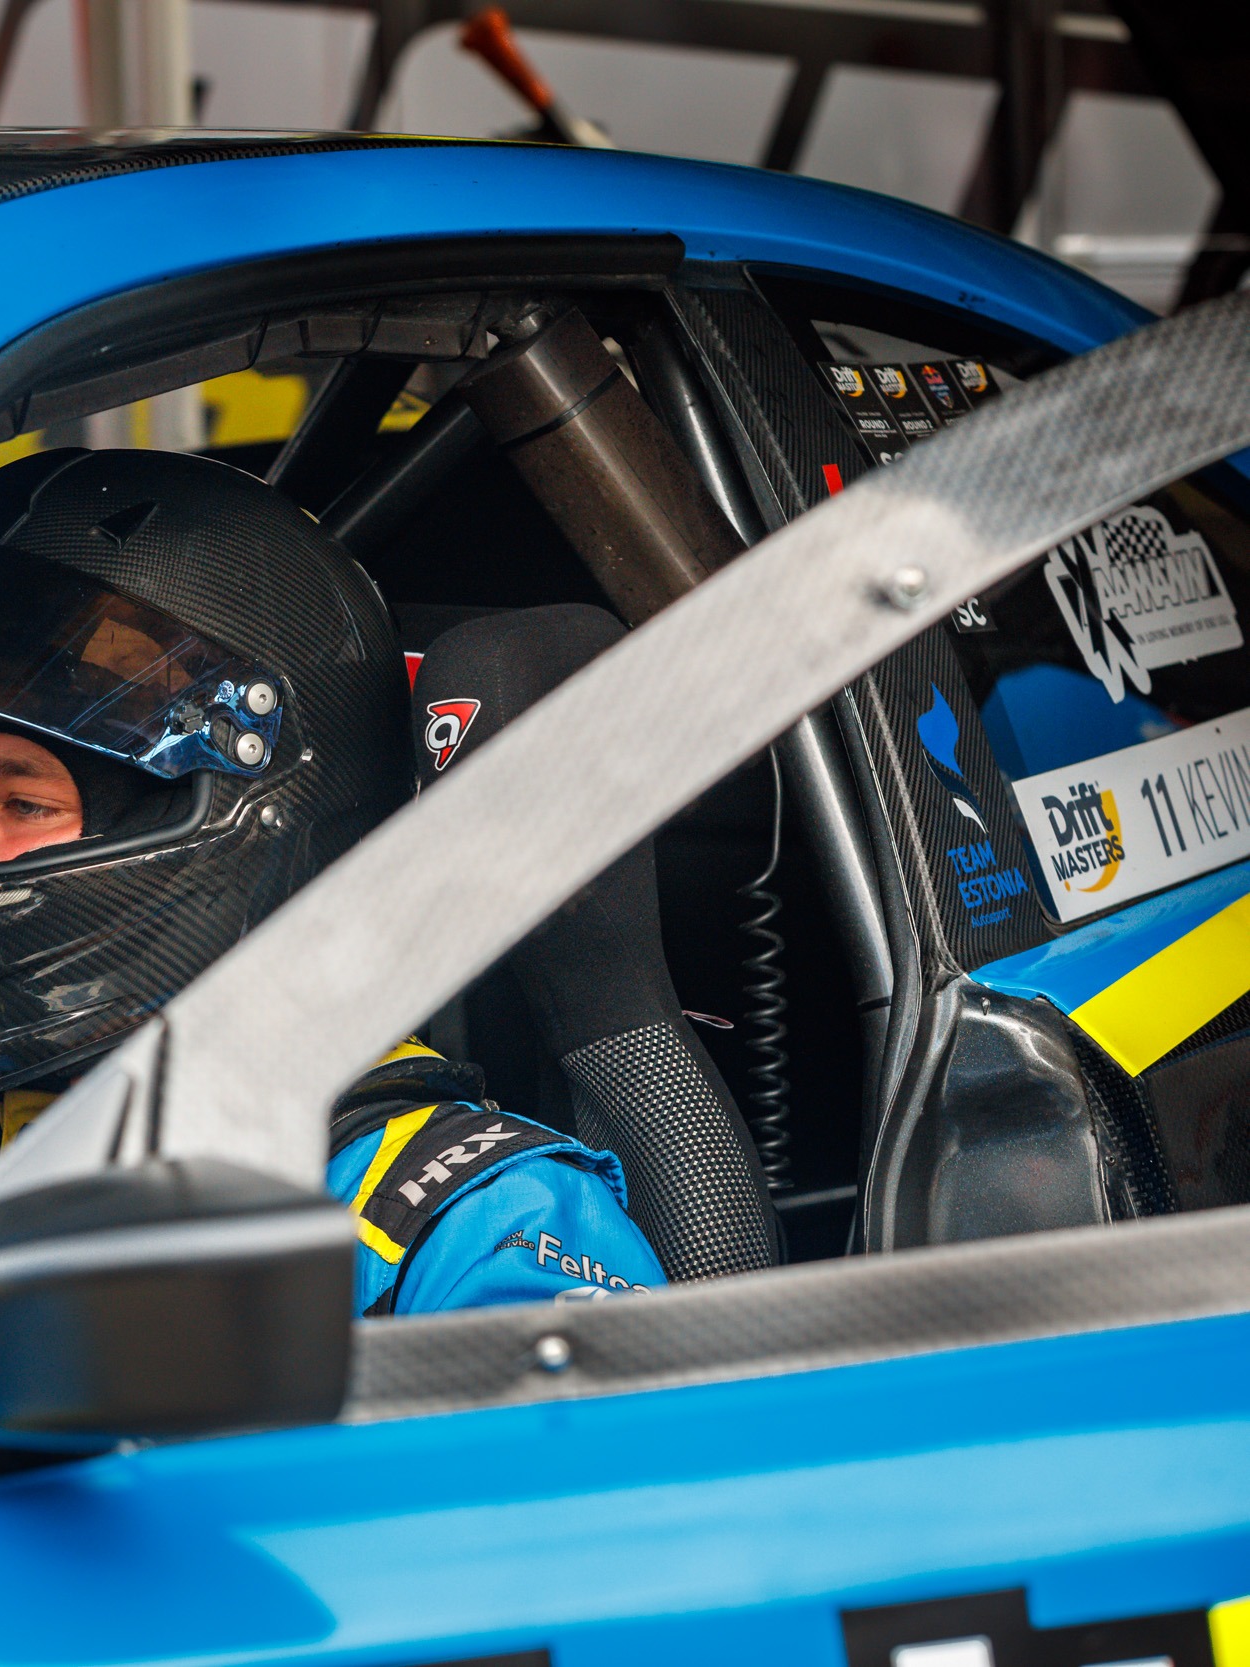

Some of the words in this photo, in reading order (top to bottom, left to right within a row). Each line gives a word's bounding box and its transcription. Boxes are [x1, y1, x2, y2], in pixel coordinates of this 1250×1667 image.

[859, 419, 885, 429] ROUND
[955, 597, 987, 627] SC
[1042, 780, 1113, 847] Drift
[1141, 773, 1187, 857] 11
[947, 840, 997, 877] TEAM
[1051, 834, 1126, 882] MASTERS
[958, 867, 1029, 909] ESTONIA
[970, 907, 1012, 929] Autosport
[398, 1122, 521, 1207] HRX
